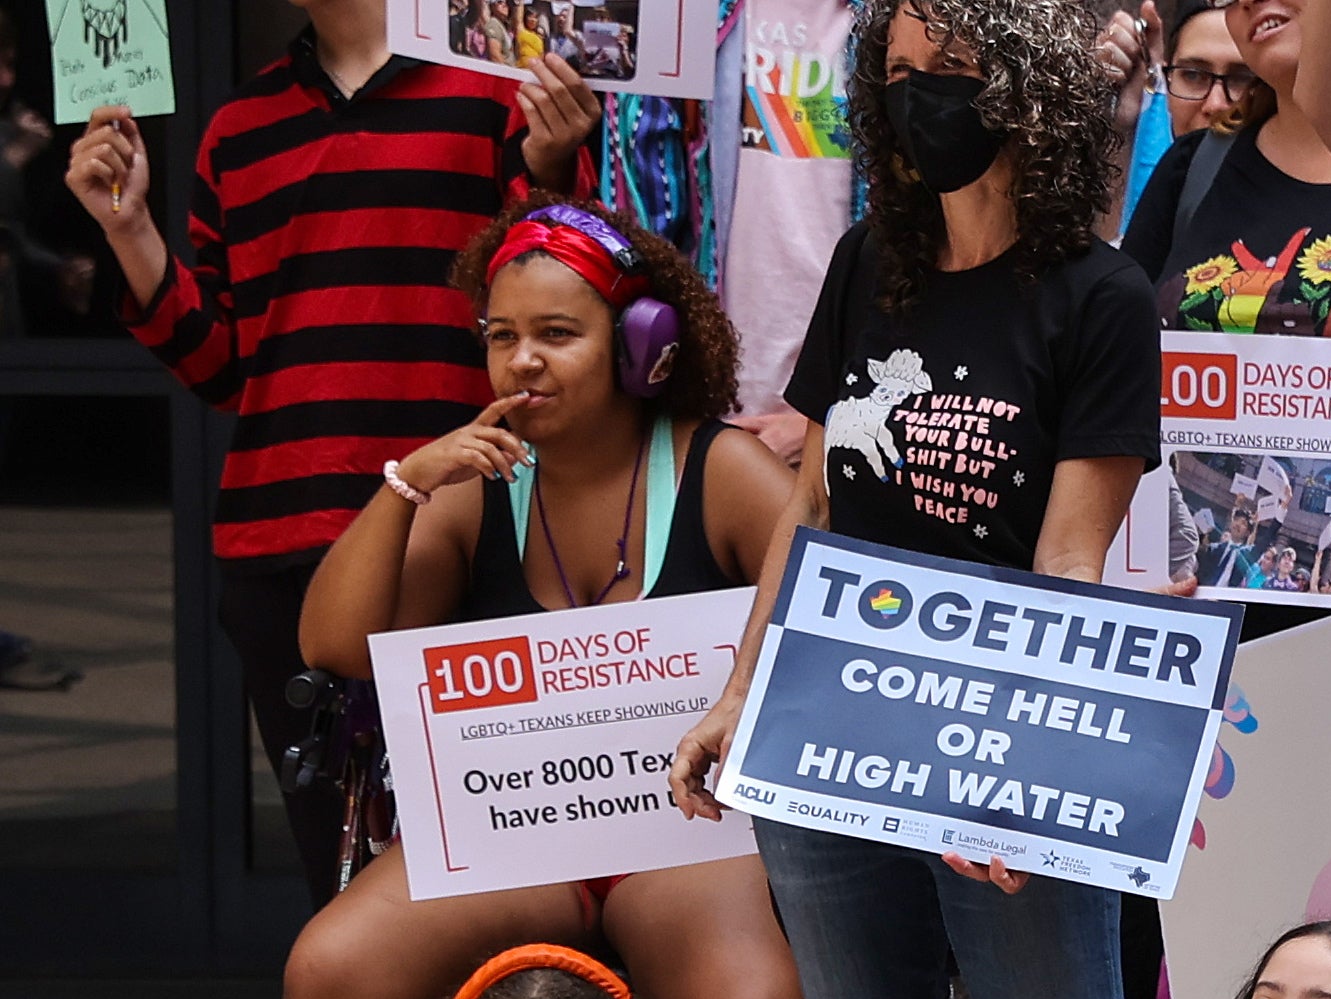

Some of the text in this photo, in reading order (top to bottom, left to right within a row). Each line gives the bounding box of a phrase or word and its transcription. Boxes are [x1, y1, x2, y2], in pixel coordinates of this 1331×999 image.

[1161, 365, 1228, 408] 00
[1243, 362, 1303, 388] DAYS
[893, 409, 990, 435] TOLERATE
[913, 394, 1021, 421] I WILL NOT
[904, 425, 950, 447] YOUR
[1160, 431, 1212, 446] LGBTQ+
[1215, 433, 1262, 448] TEXANS
[1265, 436, 1293, 450] KEEP
[906, 447, 996, 479] SHIT BUT
[895, 470, 998, 509] I WISH YOU
[913, 494, 968, 524] PEACE
[817, 565, 1202, 688] TOGETHER
[537, 628, 651, 665] DAYS OF
[434, 649, 524, 701] 100
[541, 652, 700, 694] RESISTANCE
[460, 697, 709, 740] LGBTQ+ TEXANS KEEP SHOWING UP
[841, 659, 1131, 744] COME HELL
[936, 723, 1012, 767] OR
[463, 749, 675, 796] Over 8000 Tex
[796, 742, 1126, 837] HIGH WATER
[489, 801, 558, 831] have
[565, 789, 660, 822] shown
[733, 783, 776, 805] ACLU
[958, 832, 1000, 849] Lambda
[1001, 840, 1027, 855] Legal
